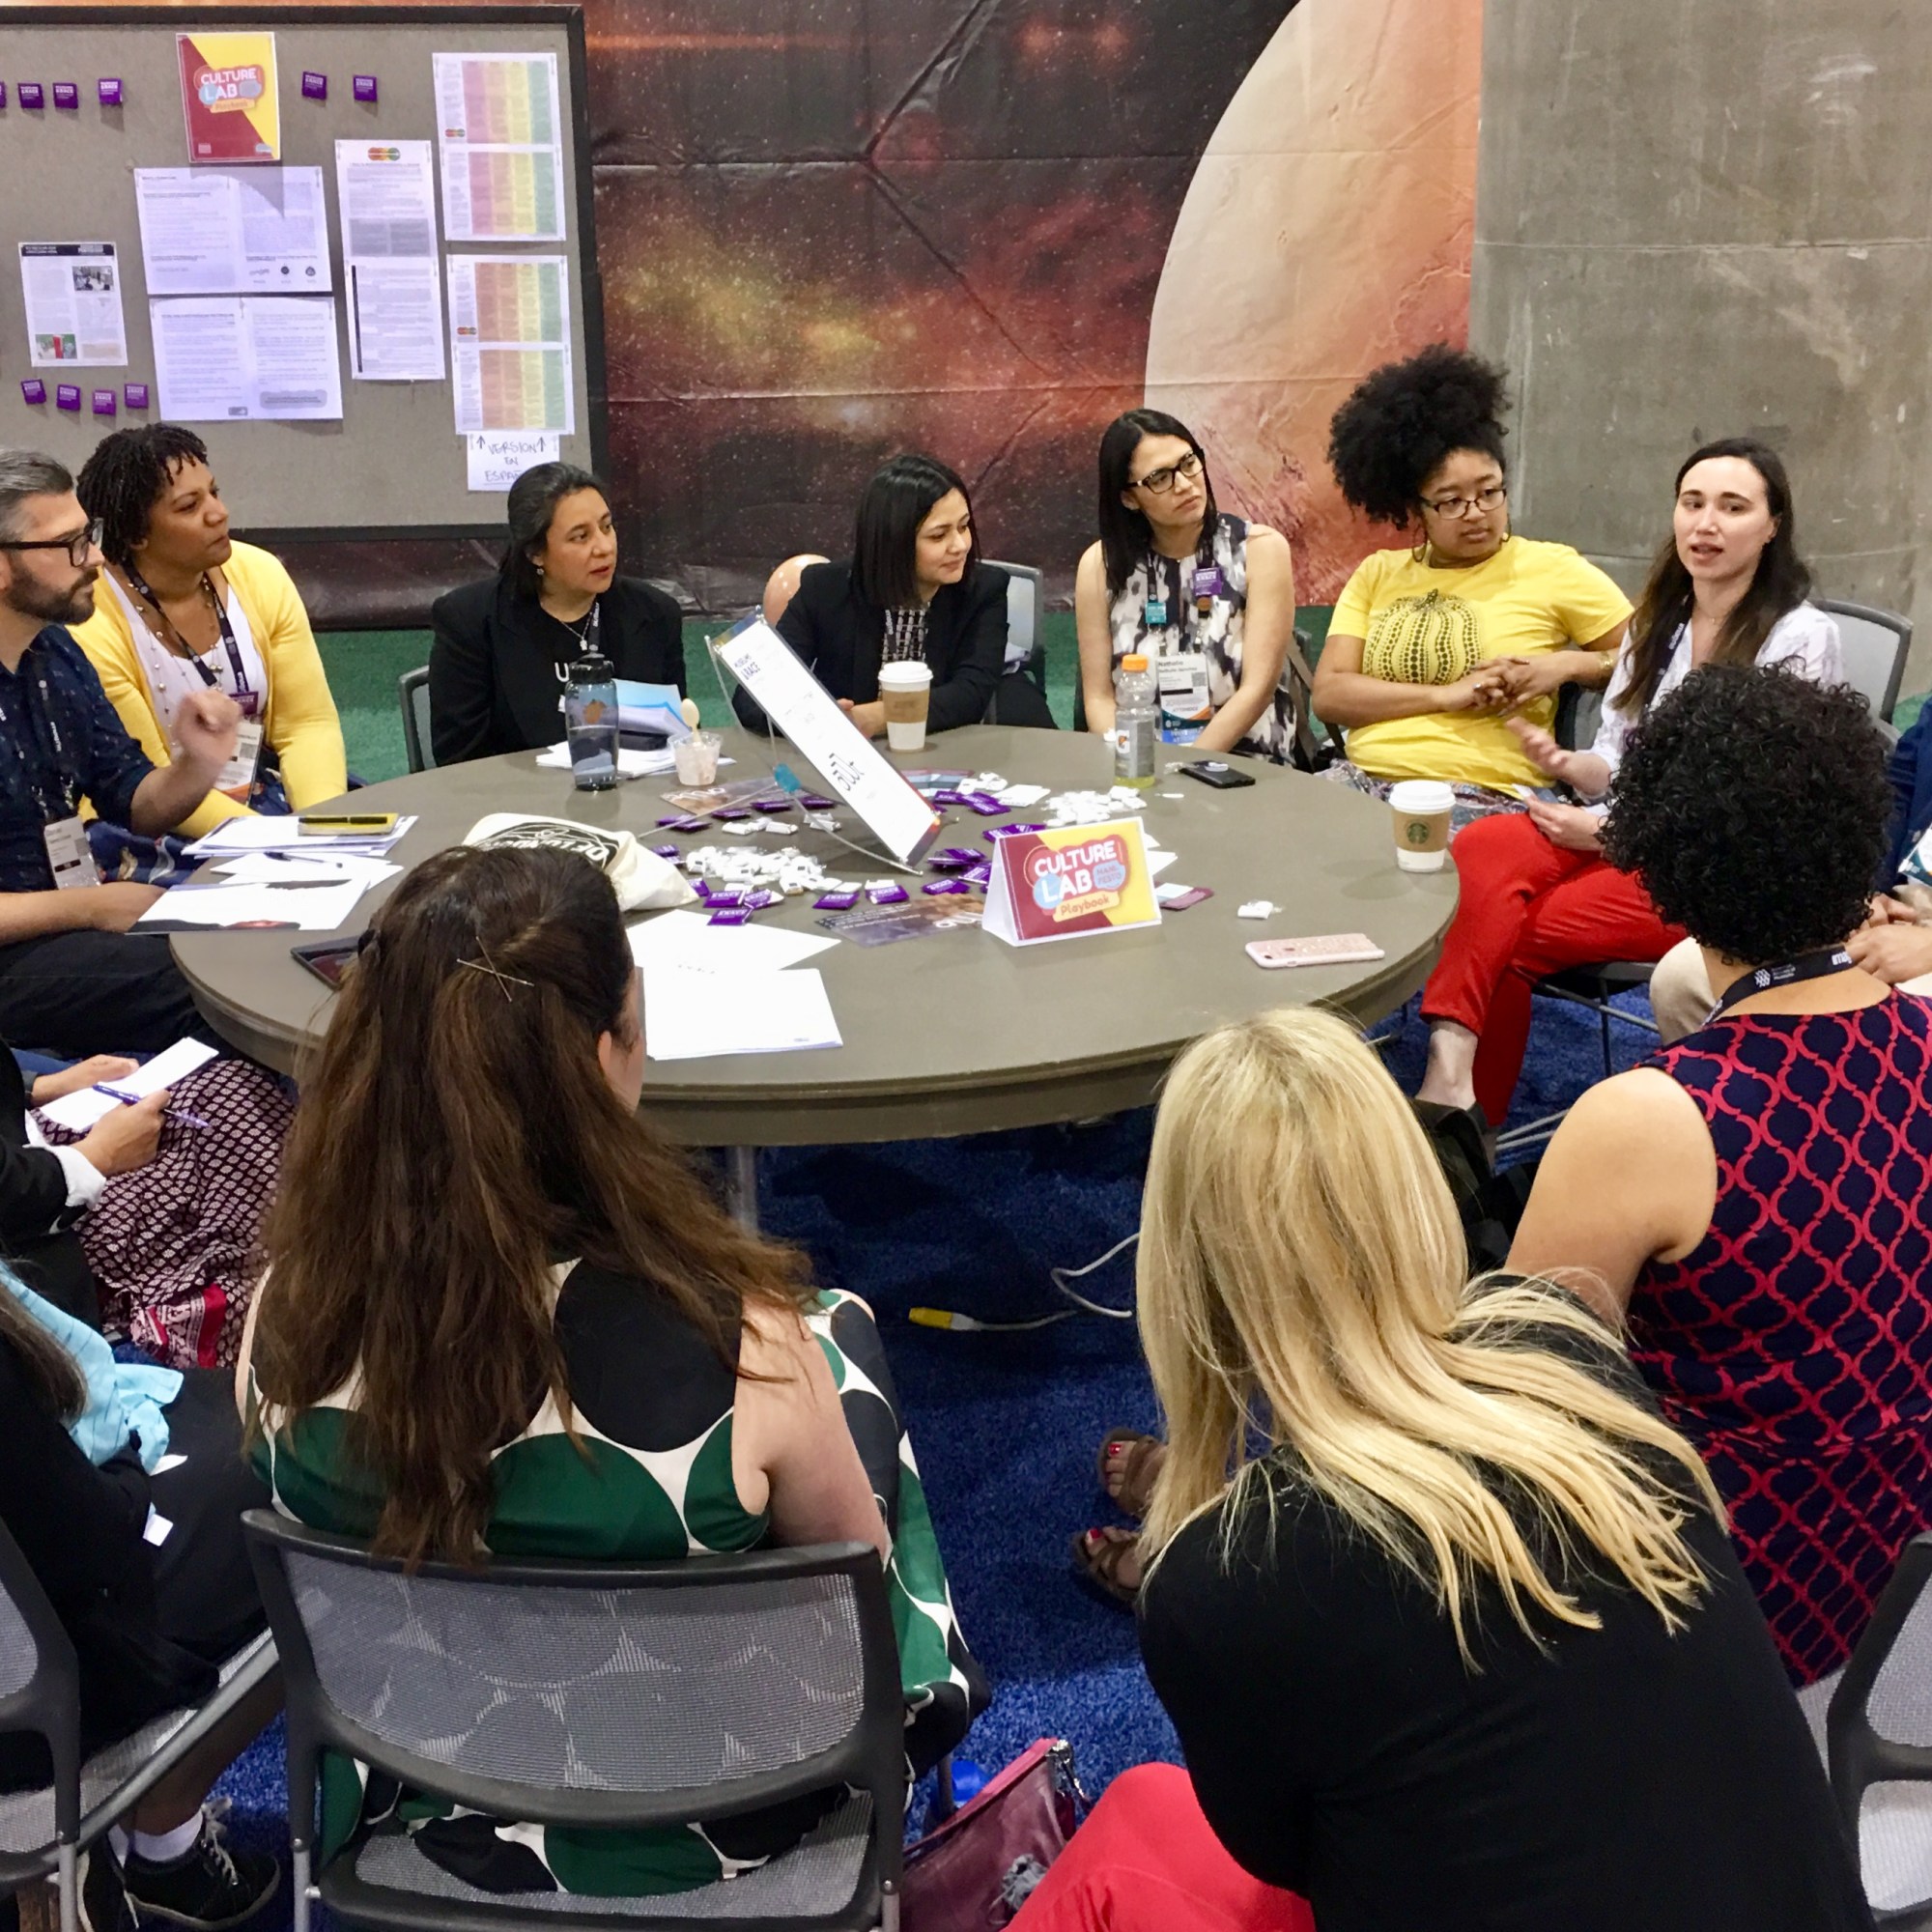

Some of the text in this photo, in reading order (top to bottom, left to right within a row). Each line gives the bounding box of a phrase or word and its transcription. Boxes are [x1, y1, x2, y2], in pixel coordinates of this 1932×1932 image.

[201, 68, 257, 85] CULTURE
[205, 84, 238, 101] LAB
[485, 469, 523, 482] ESPAÑ
[1116, 730, 1130, 753] G
[1035, 839, 1117, 878] CULTURE
[1041, 869, 1093, 904] LAB
[1061, 895, 1110, 917] Playbook
